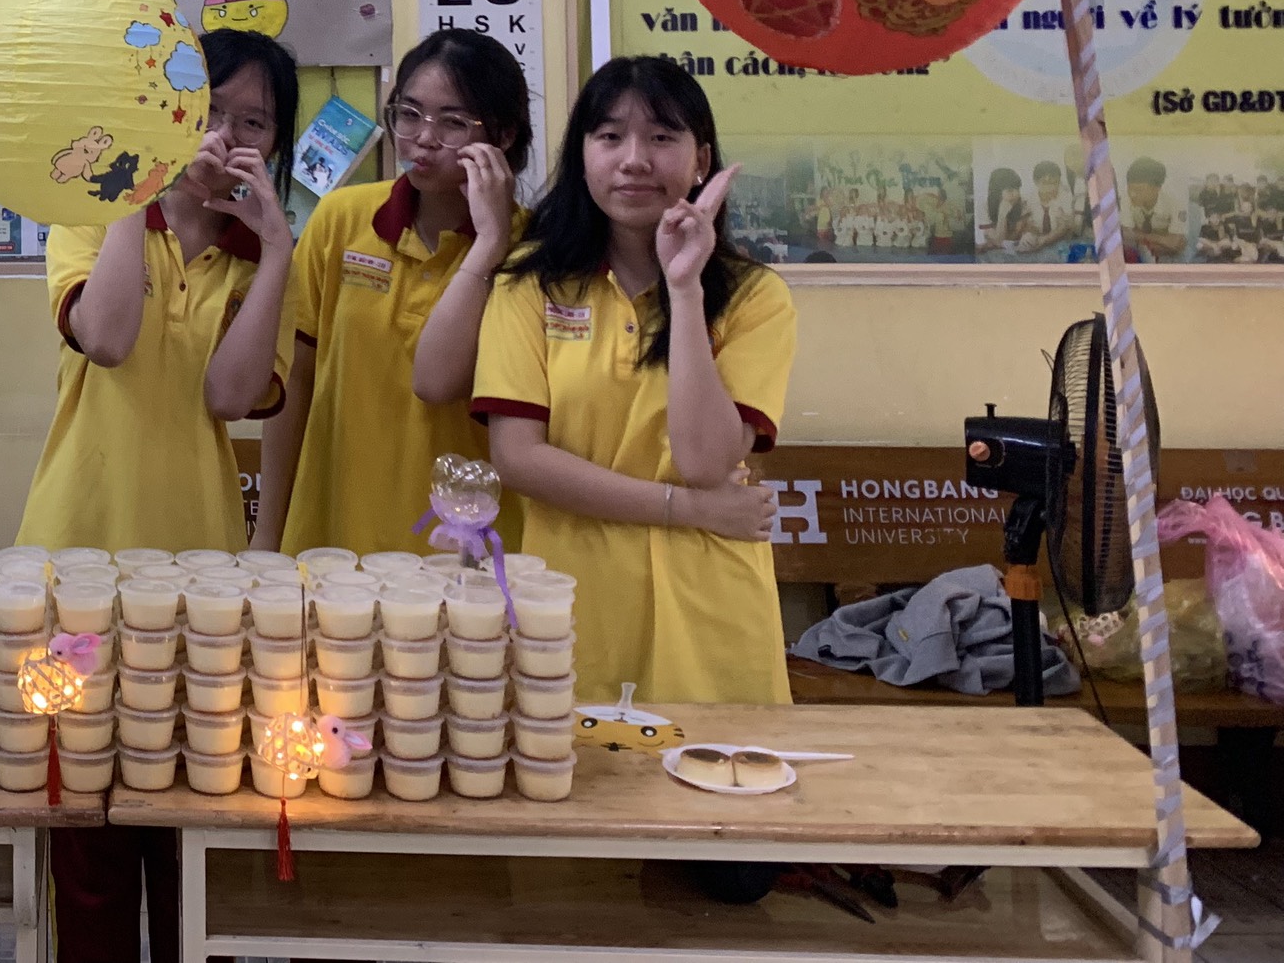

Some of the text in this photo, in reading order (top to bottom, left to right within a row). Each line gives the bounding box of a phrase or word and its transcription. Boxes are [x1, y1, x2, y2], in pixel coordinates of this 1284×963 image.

[509, 14, 526, 33] K
[641, 7, 698, 32] văn
[1120, 0, 1159, 30] về
[1173, 3, 1203, 30] lý
